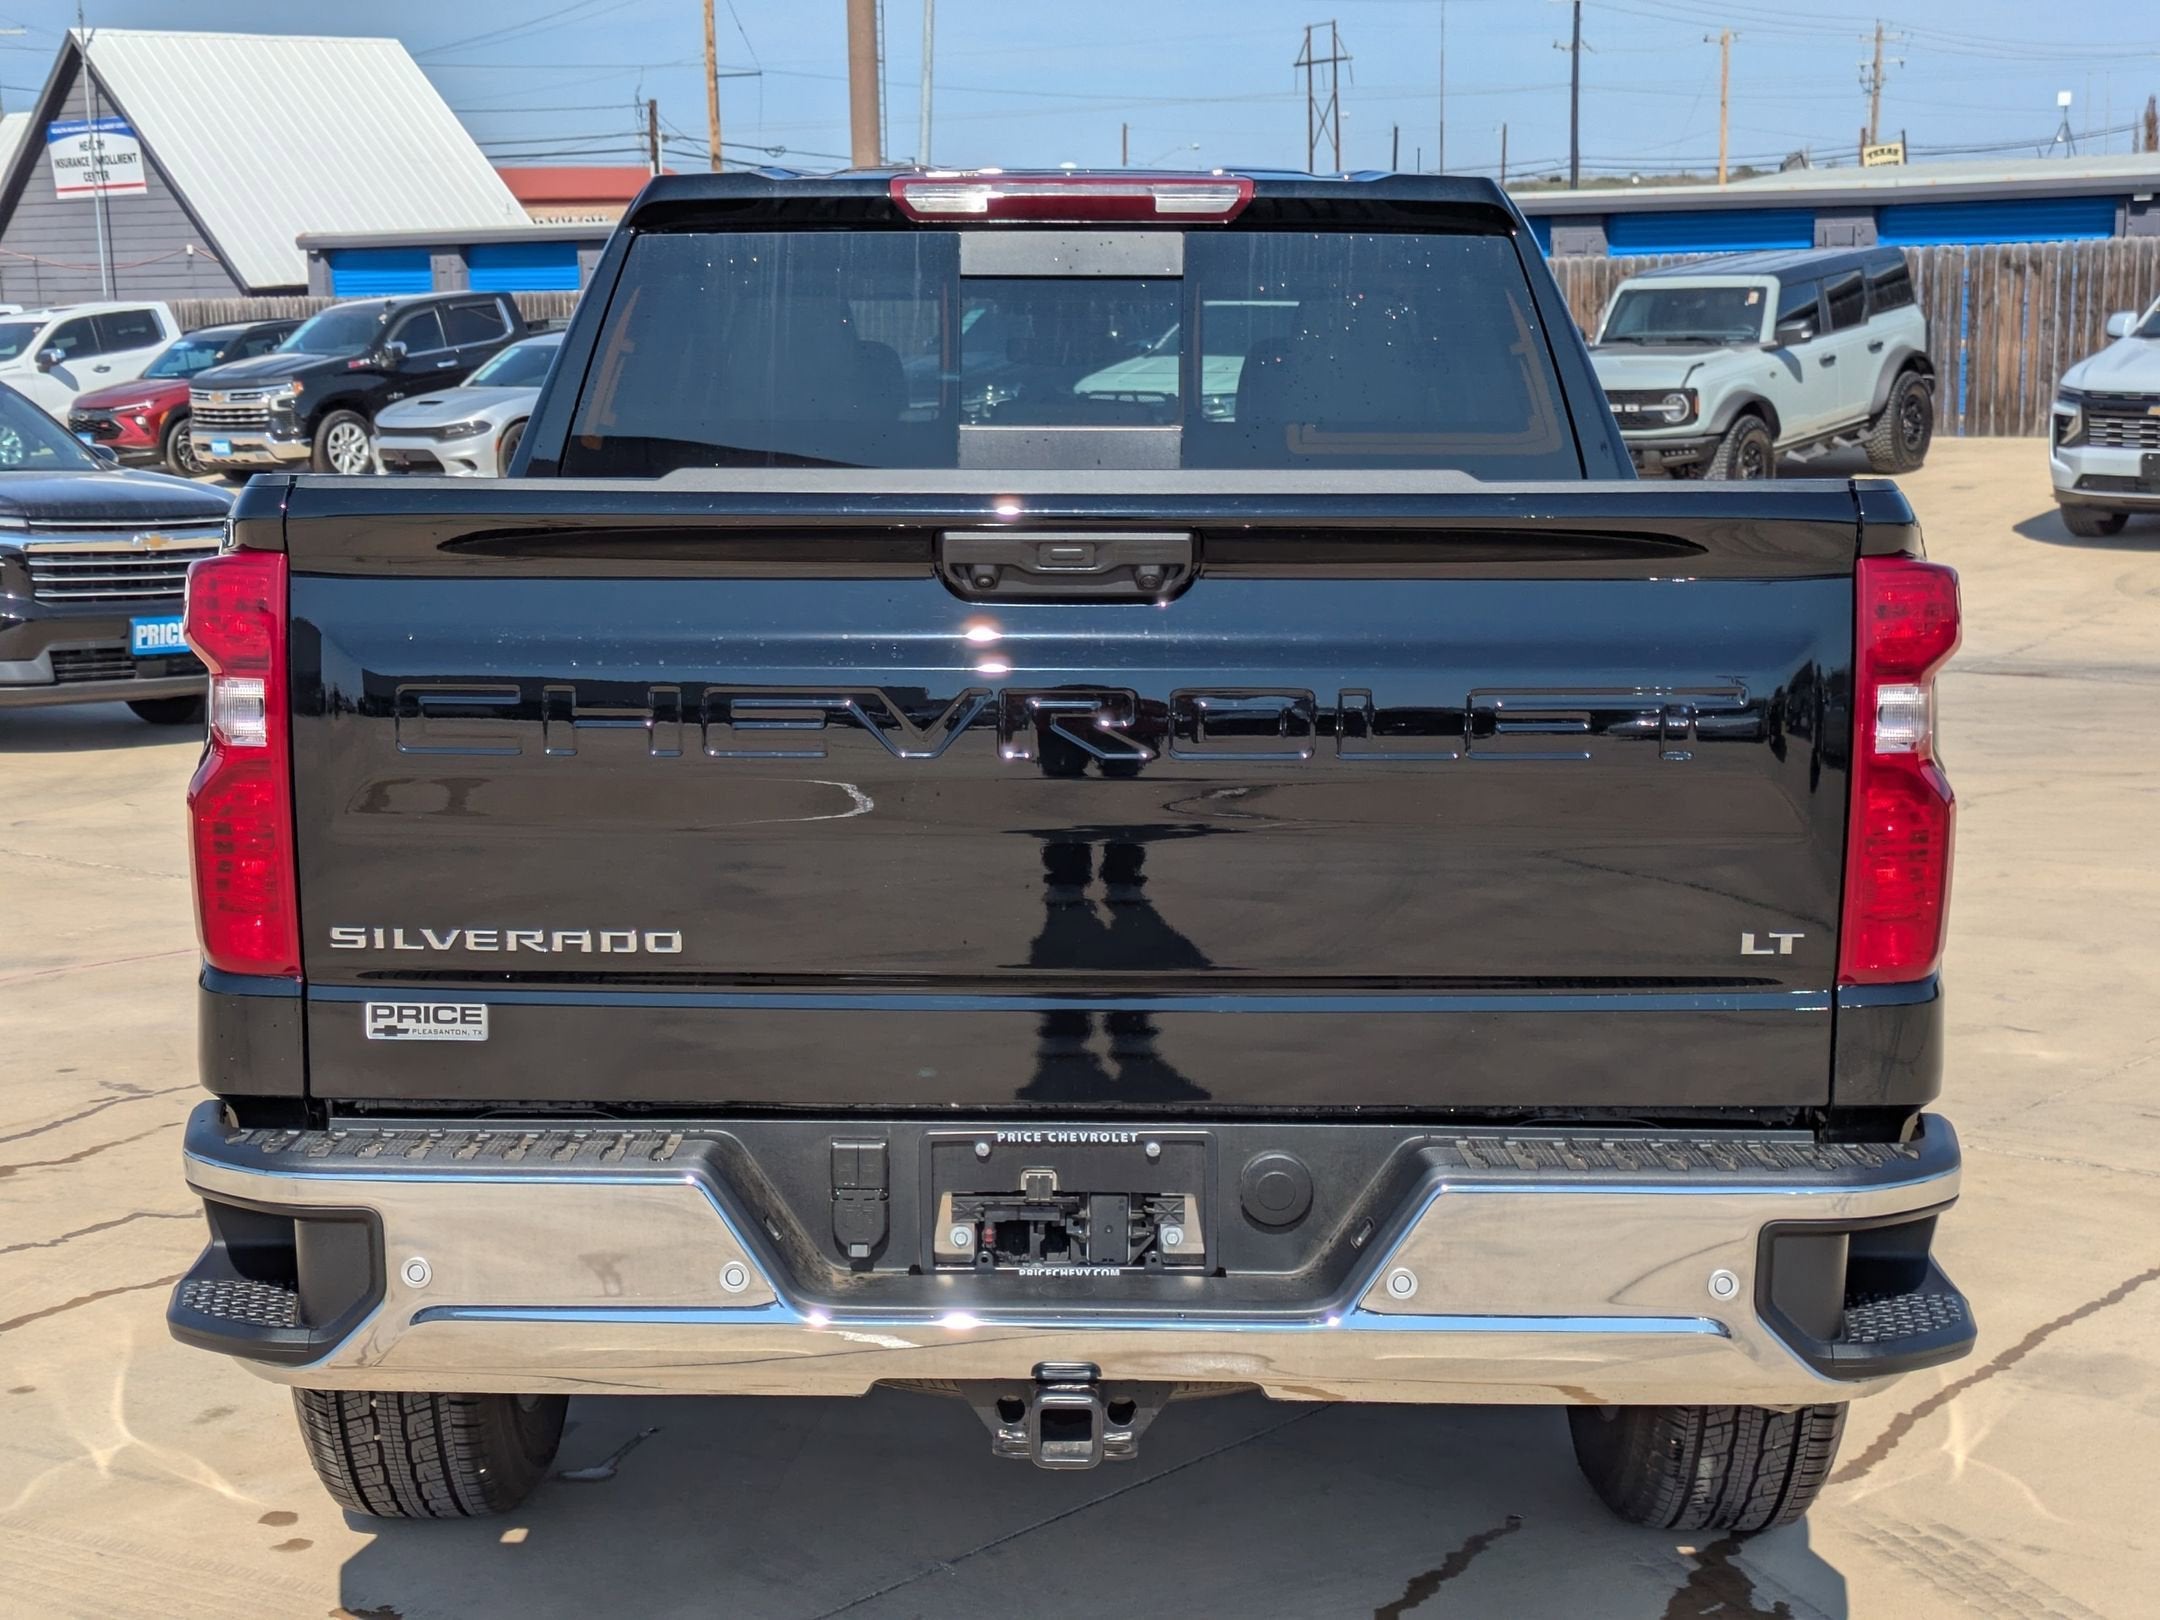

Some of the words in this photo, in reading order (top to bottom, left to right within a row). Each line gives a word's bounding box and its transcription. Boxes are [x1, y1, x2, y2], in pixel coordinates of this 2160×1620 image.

[55, 157, 90, 168] INSURANCE
[93, 153, 137, 165] NROLLMENT
[395, 684, 1749, 761] CHEVROLET
[329, 926, 684, 954] SILVERADO
[1741, 932, 1805, 954] LT
[371, 1005, 482, 1025] PRICE
[411, 1028, 470, 1037] PLEASANTON,
[997, 1131, 1041, 1142] PRICE
[1047, 1131, 1139, 1143] CHEVROLET
[1018, 1267, 1120, 1276] PRICECHEVYCOM
